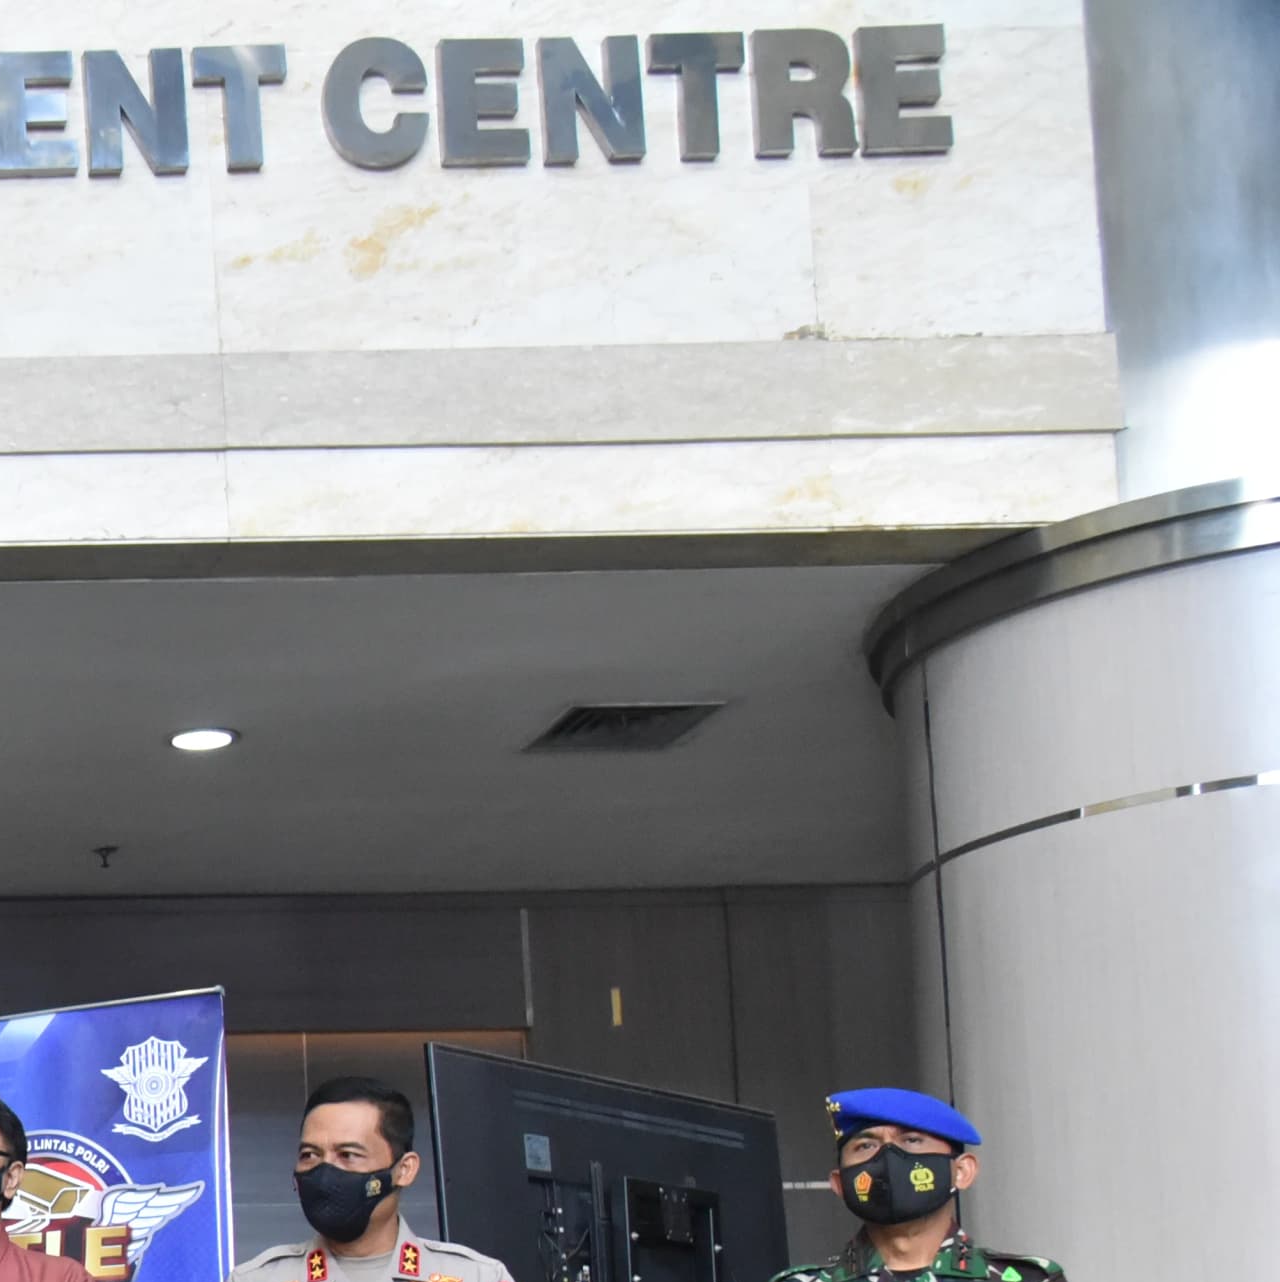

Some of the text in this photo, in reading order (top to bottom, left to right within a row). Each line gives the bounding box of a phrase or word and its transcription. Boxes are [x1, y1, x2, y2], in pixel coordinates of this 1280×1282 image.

[320, 24, 955, 171] CENTRE
[33, 1138, 75, 1154] LINTAS
[74, 1145, 111, 1175] POLRI
